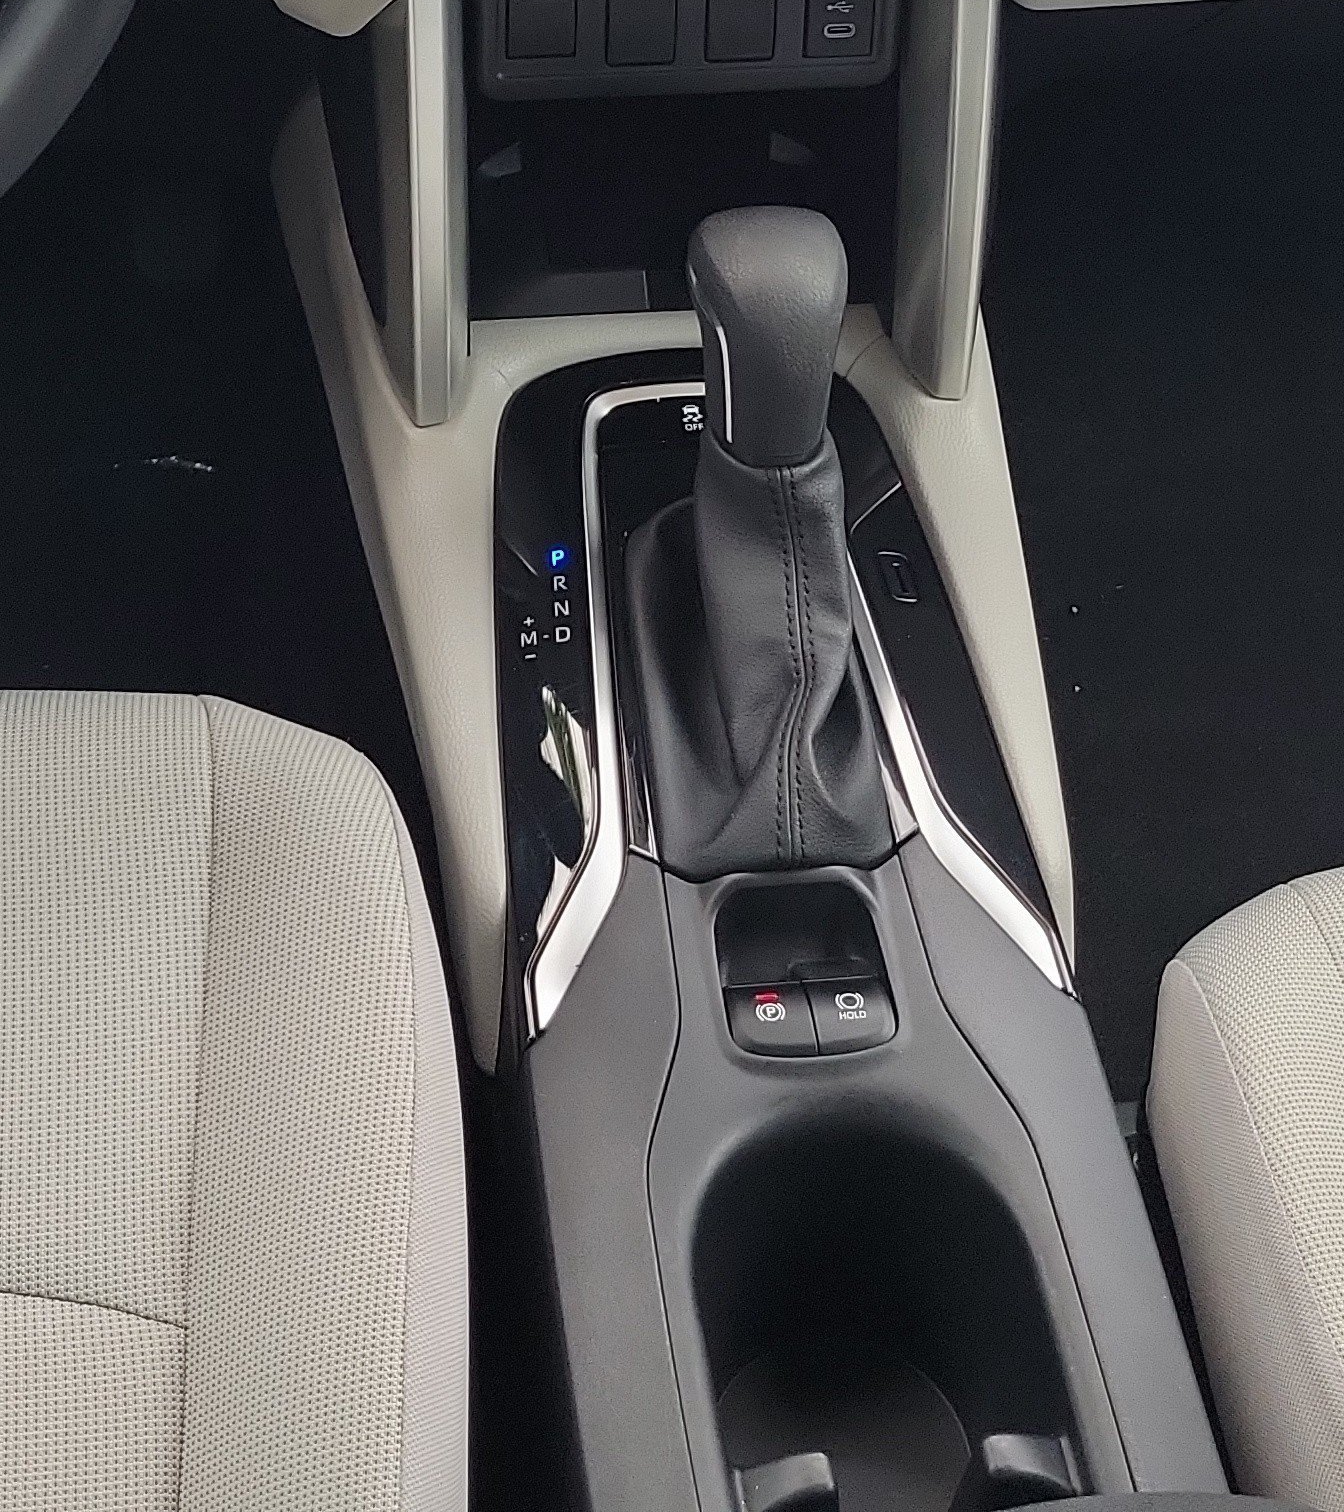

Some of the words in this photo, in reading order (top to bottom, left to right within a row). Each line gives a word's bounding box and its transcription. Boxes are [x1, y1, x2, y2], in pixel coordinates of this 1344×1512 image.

[684, 423, 704, 431] OFF
[551, 550, 565, 566] P
[554, 575, 568, 591] R
[554, 600, 570, 617] N
[520, 630, 538, 648] M
[555, 626, 571, 643] D
[839, 1010, 867, 1020] HOLD
